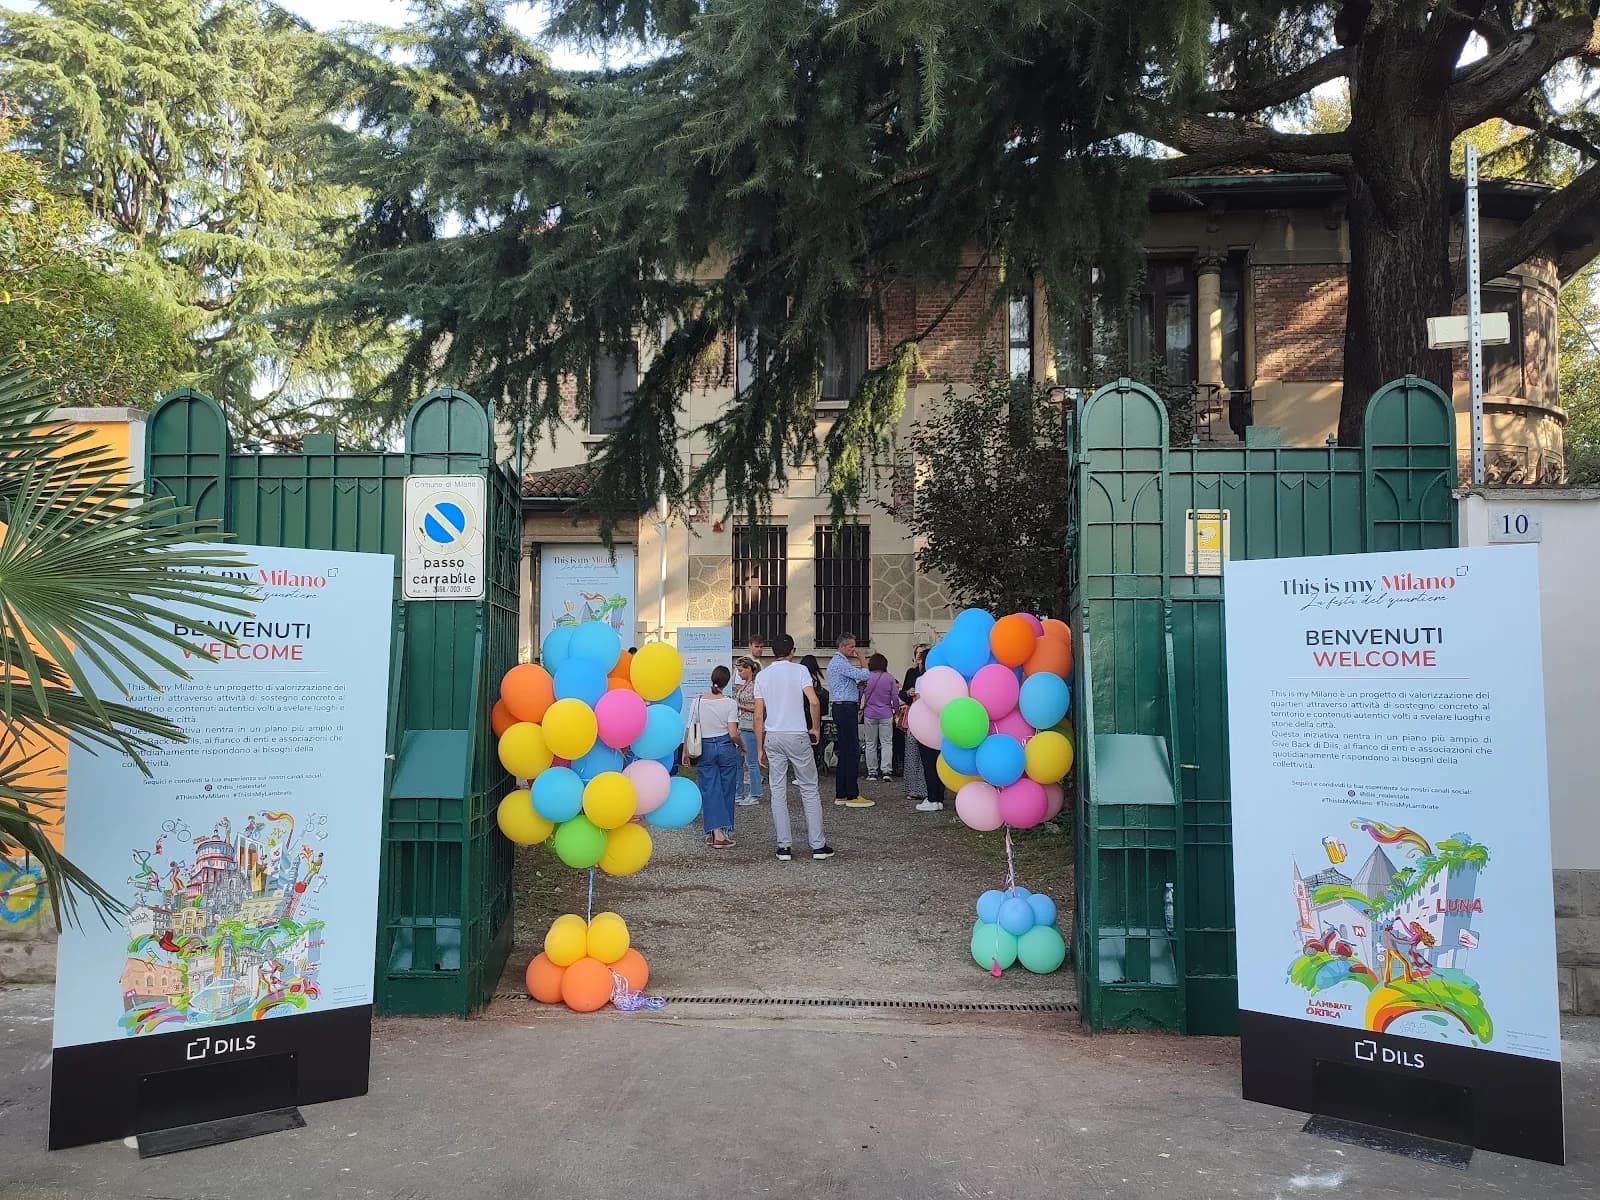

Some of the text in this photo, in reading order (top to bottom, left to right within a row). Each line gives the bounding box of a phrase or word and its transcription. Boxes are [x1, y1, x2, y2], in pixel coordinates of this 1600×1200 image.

[414, 481, 443, 489] Comune
[454, 480, 476, 488] Milano
[1503, 514, 1529, 534] 10
[424, 559, 465, 570] passo
[258, 569, 327, 588] Milano
[412, 572, 476, 584] carrabile
[1280, 573, 1456, 596] This is my Milano
[1306, 627, 1442, 646] BENVENUTI
[1312, 650, 1438, 668] WELCOME
[174, 683, 204, 691] Milano
[227, 684, 264, 692] progetto
[216, 694, 246, 702] attività
[301, 694, 336, 702] concreto
[1271, 690, 1286, 698] This
[1288, 690, 1296, 698] is
[1312, 690, 1338, 698] Milano
[1340, 690, 1345, 698] è
[1360, 692, 1396, 700] progetto
[174, 704, 216, 712] contenuti
[218, 704, 254, 712] autentici
[257, 704, 274, 712] volti
[284, 704, 311, 712] svelare
[1354, 712, 1390, 720] autentici
[1454, 714, 1482, 722] luoghi
[264, 726, 288, 734] piano
[1294, 720, 1314, 728] della
[214, 736, 240, 744] fianco
[1272, 730, 1300, 738] Questa
[1304, 731, 1339, 739] iniziativa
[1402, 734, 1427, 742] piano
[1432, 734, 1445, 743] più
[1450, 735, 1479, 744] ampio
[202, 748, 250, 756] rispondono
[1272, 740, 1290, 748] Give
[1292, 740, 1310, 748] Back
[1392, 744, 1408, 752] enti
[1418, 746, 1473, 754] associazioni
[1476, 747, 1493, 755] che
[1272, 751, 1340, 760] quotidianamente
[1341, 753, 1390, 762] rispondono
[1402, 756, 1434, 764] bisogni
[1436, 898, 1484, 914] LUNA
[1308, 999, 1352, 1011] LAMBRATE
[1306, 1007, 1342, 1019] ORTICA
[214, 1035, 256, 1055] DILS
[1382, 1047, 1425, 1069] DILS
